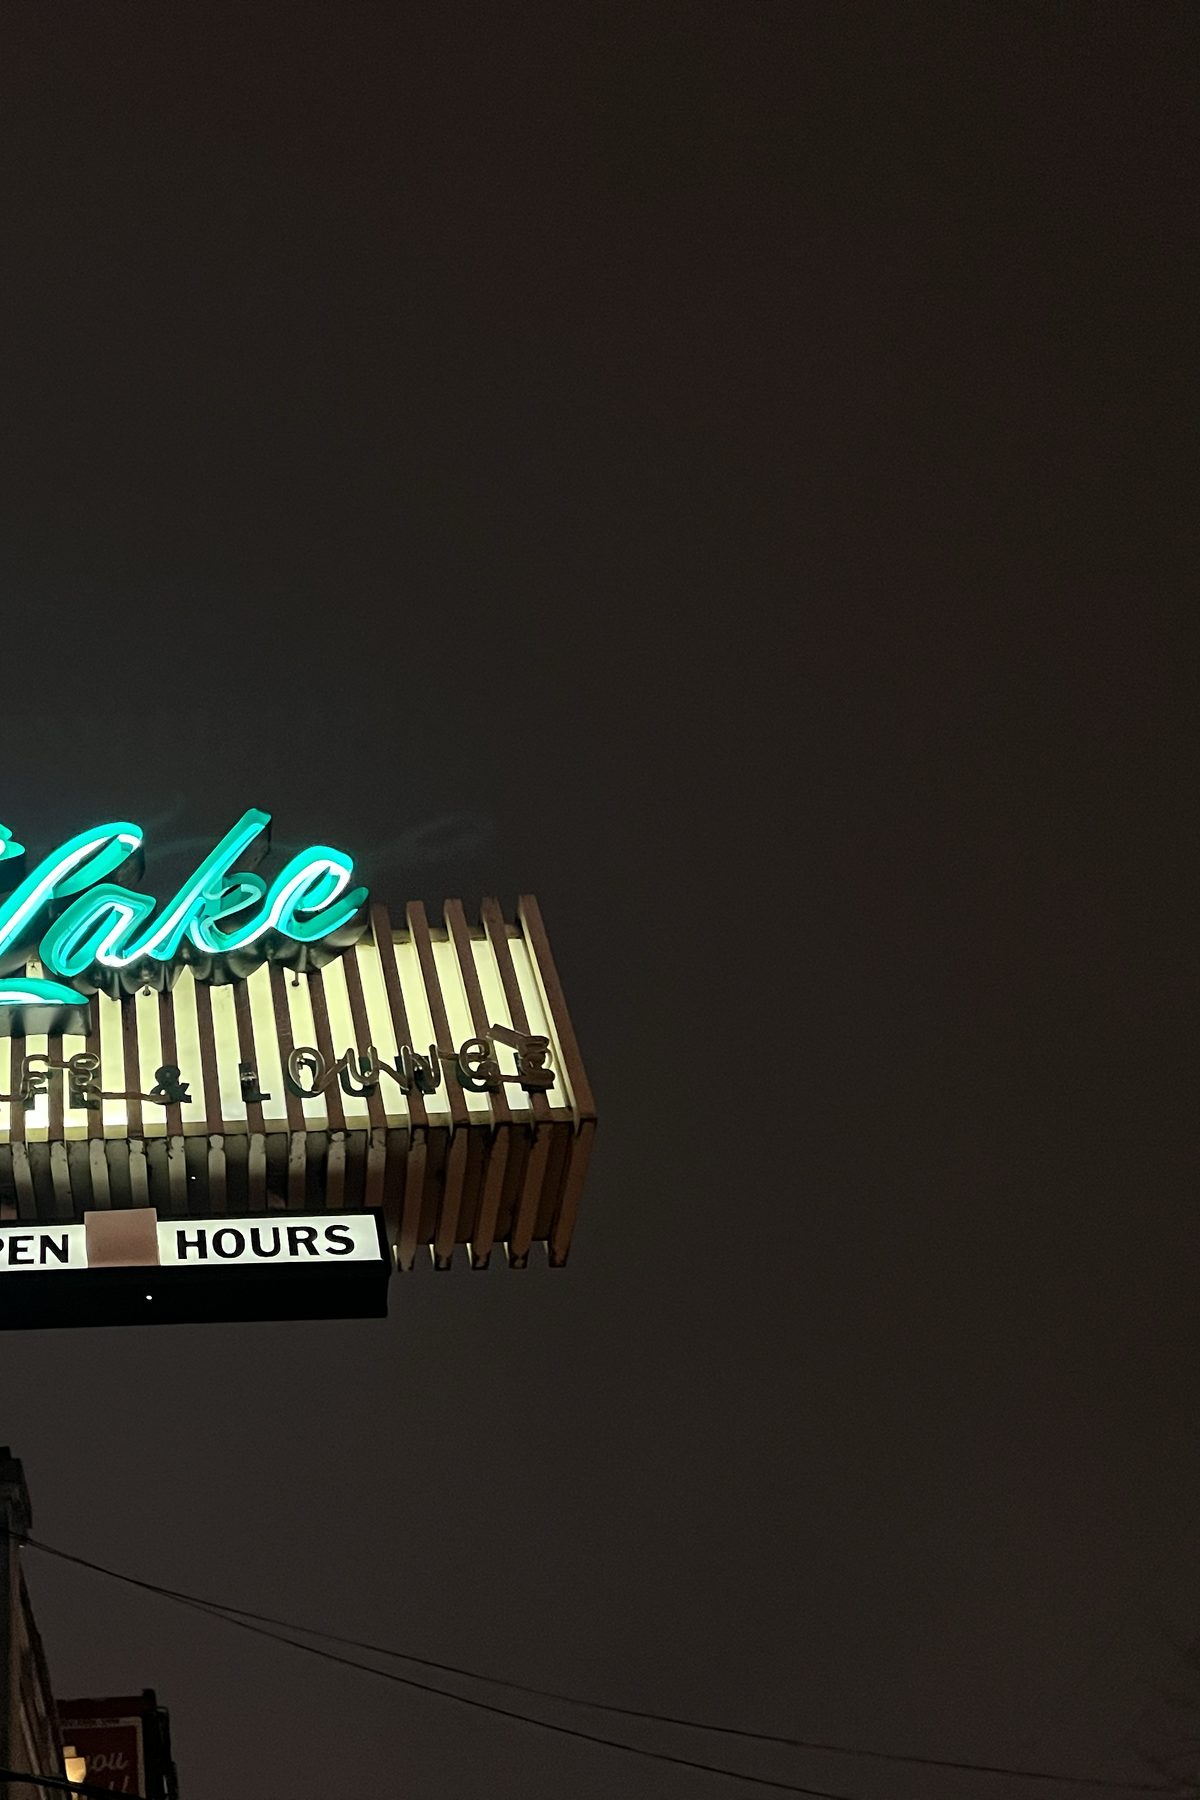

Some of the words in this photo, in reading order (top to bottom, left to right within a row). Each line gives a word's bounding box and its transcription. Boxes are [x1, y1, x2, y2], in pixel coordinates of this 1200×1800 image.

[150, 1065, 192, 1106] &
[238, 1033, 556, 1101] LOUNGE
[175, 1223, 356, 1260] HOURS
